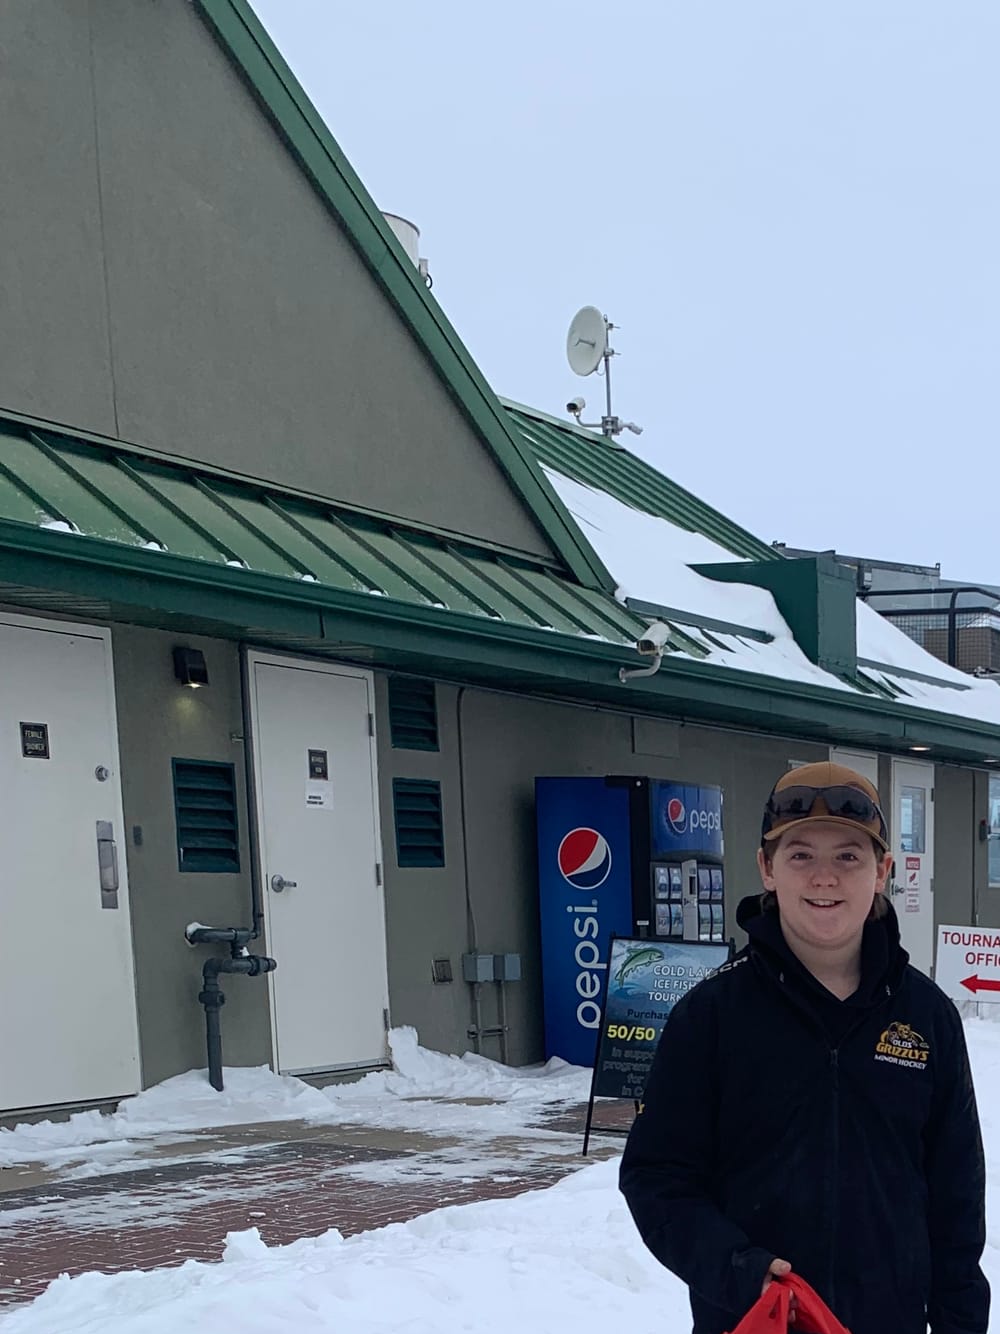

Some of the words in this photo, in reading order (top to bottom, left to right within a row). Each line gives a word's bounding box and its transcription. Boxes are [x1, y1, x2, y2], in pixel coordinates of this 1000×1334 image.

[566, 905, 607, 1029] pepsi
[653, 965, 685, 976] COLD
[688, 967, 713, 978] LAK
[653, 979, 671, 989] ICE
[673, 980, 697, 990] FISH
[627, 1009, 668, 1020] Purchas
[607, 1024, 656, 1041] 50/50
[876, 1042, 930, 1061] GRIZZLYS
[874, 1054, 898, 1064] MINOR
[898, 1059, 928, 1070] HOCKEY
